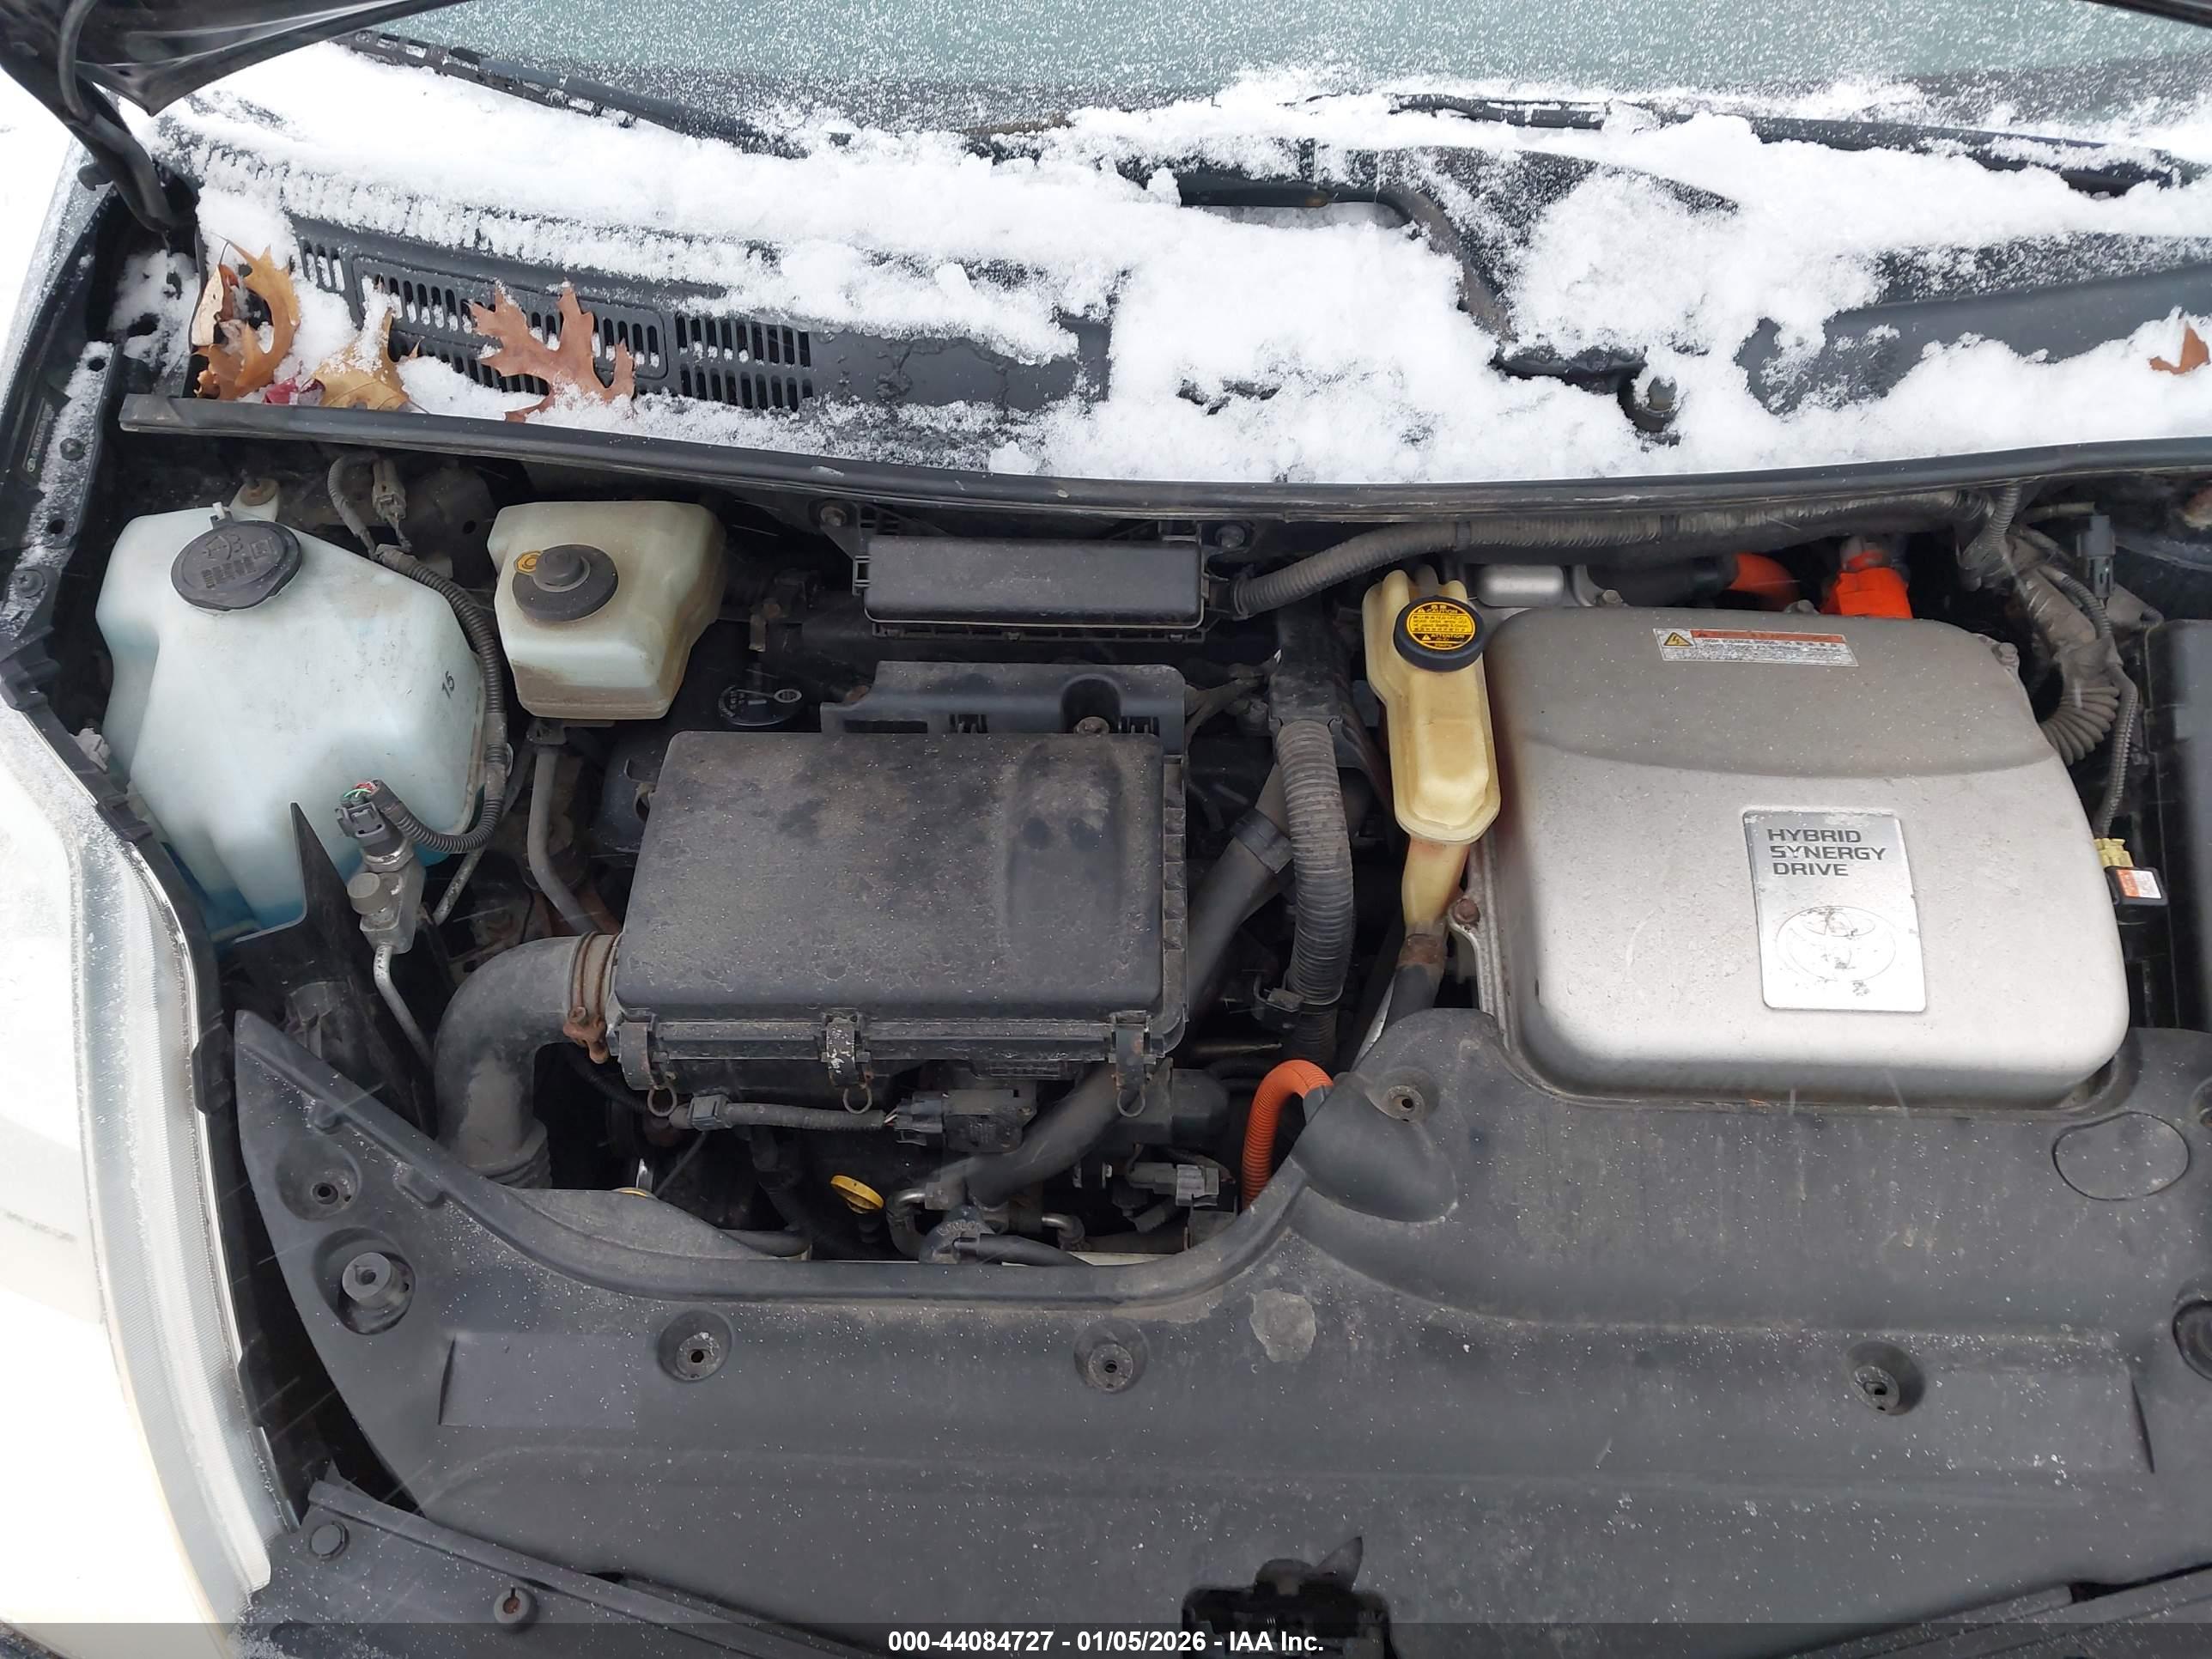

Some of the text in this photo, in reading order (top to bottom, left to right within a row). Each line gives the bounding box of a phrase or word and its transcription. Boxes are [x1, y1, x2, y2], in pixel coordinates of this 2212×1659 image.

[1767, 829, 1862, 843] HYBRID
[1770, 845, 1887, 860] SYNERGY
[1772, 862, 1849, 877] DRIVE
